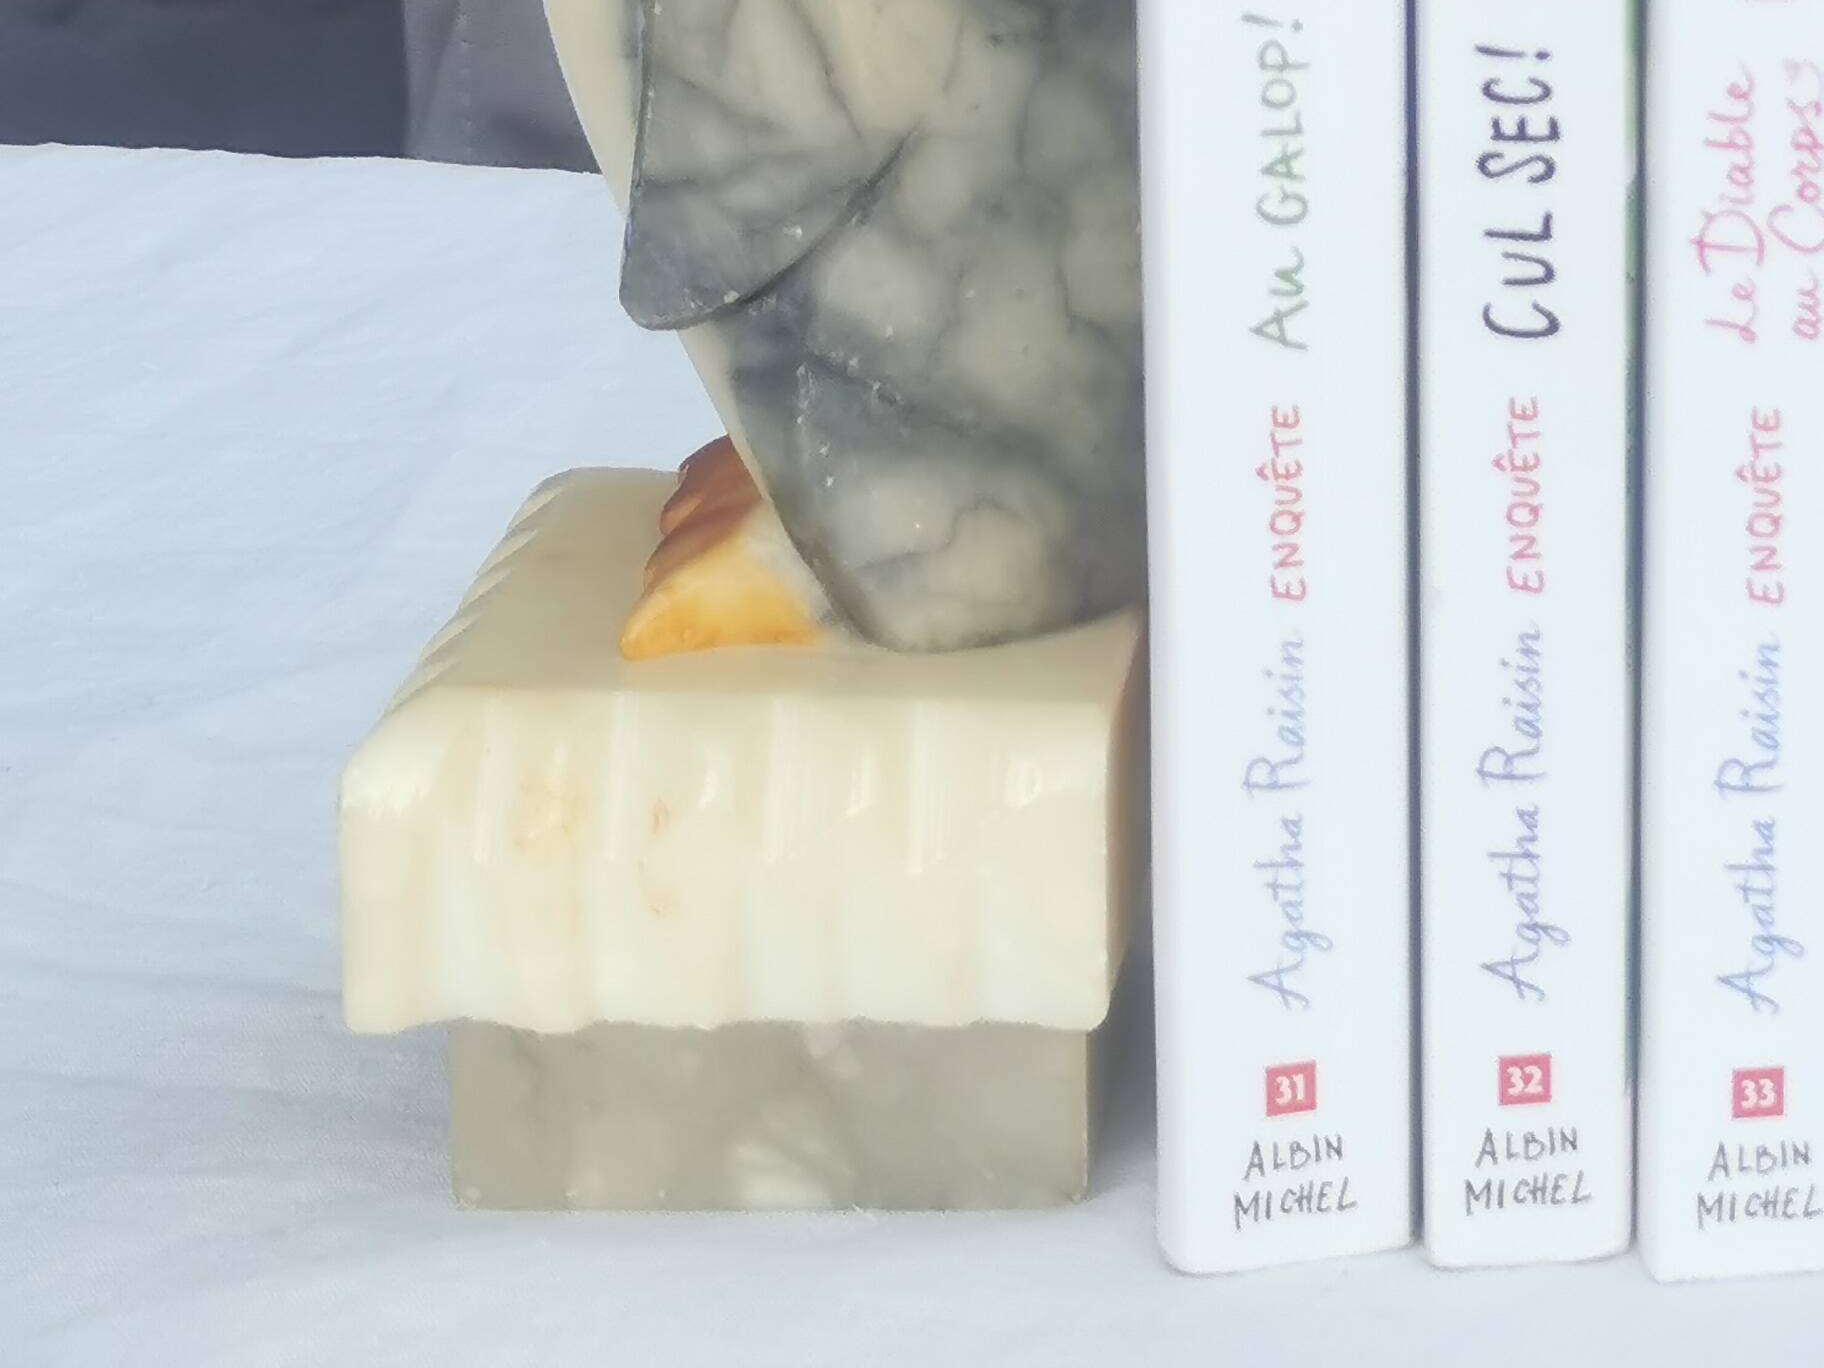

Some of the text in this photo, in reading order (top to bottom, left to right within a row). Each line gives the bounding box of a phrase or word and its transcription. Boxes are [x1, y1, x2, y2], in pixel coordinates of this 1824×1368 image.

[1240, 12, 1310, 228] GALOP!
[1687, 76, 1760, 274] Diable
[1472, 42, 1565, 342] CUL SEC!
[1790, 277, 1824, 342] au
[1241, 403, 1335, 1010] Agatha Raisin ENQUÊTE
[1474, 395, 1573, 1003] Agatha Raisin ENQUÊTE
[1712, 405, 1806, 1015] Agatha Raisin ENQUÊTE
[1232, 1172, 1359, 1234] MICHEL
[1240, 1132, 1351, 1183] ALBIN
[1462, 1164, 1594, 1218] MICHEL
[1473, 1124, 1580, 1170] ALBIN
[1706, 1138, 1815, 1188] ALBIN
